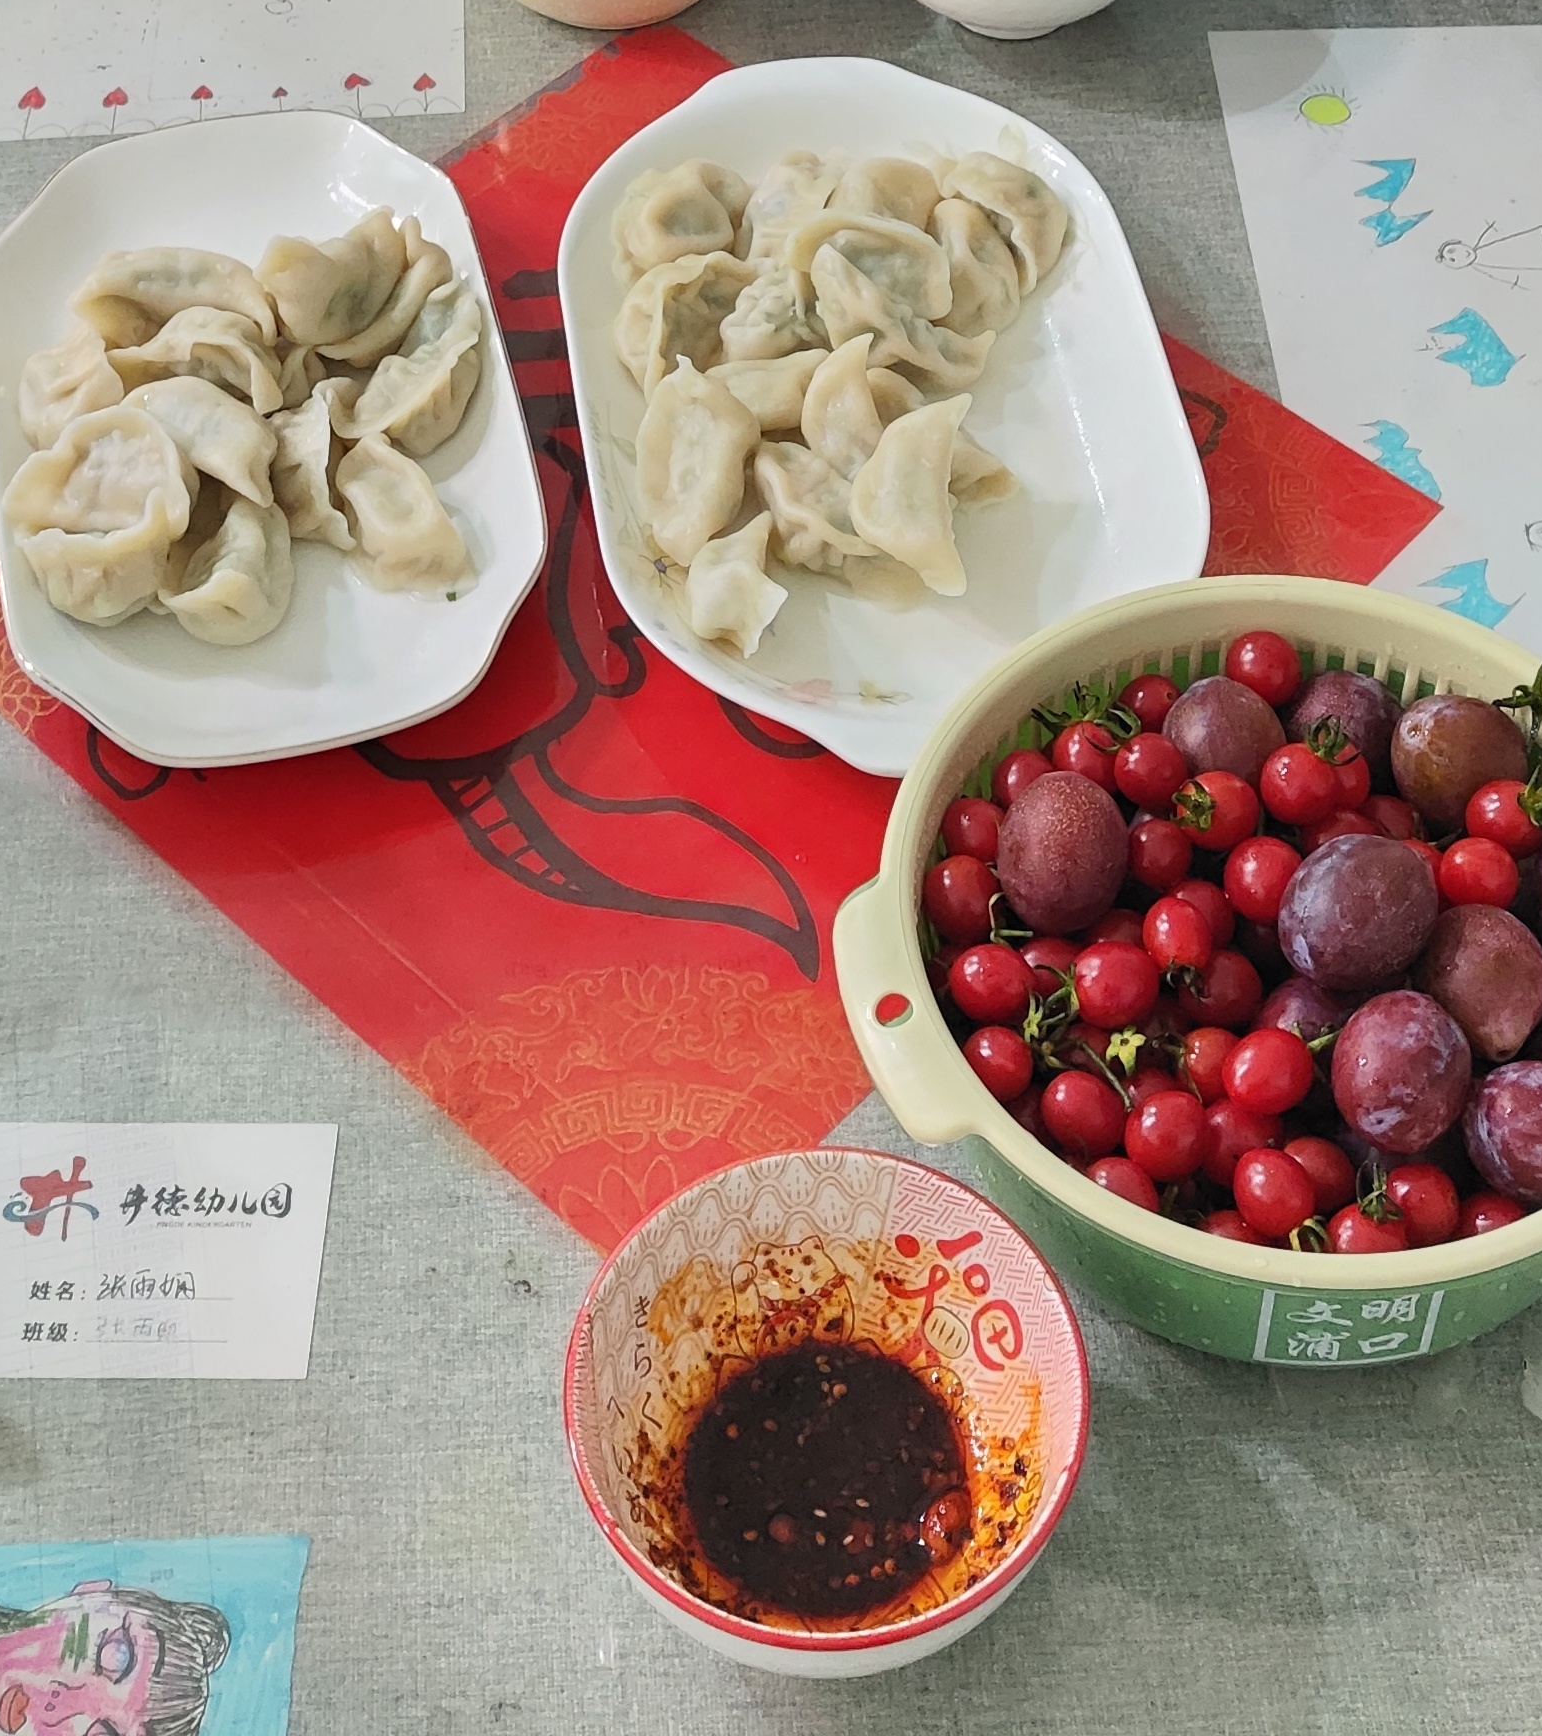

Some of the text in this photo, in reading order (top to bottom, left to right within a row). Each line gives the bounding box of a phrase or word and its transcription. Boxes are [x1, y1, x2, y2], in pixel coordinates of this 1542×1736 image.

[119, 1182, 293, 1226] 井德幼儿园
[1286, 1292, 1421, 1327] 文明
[632, 1295, 663, 1431] きらく
[1287, 1331, 1409, 1361] 浦口
